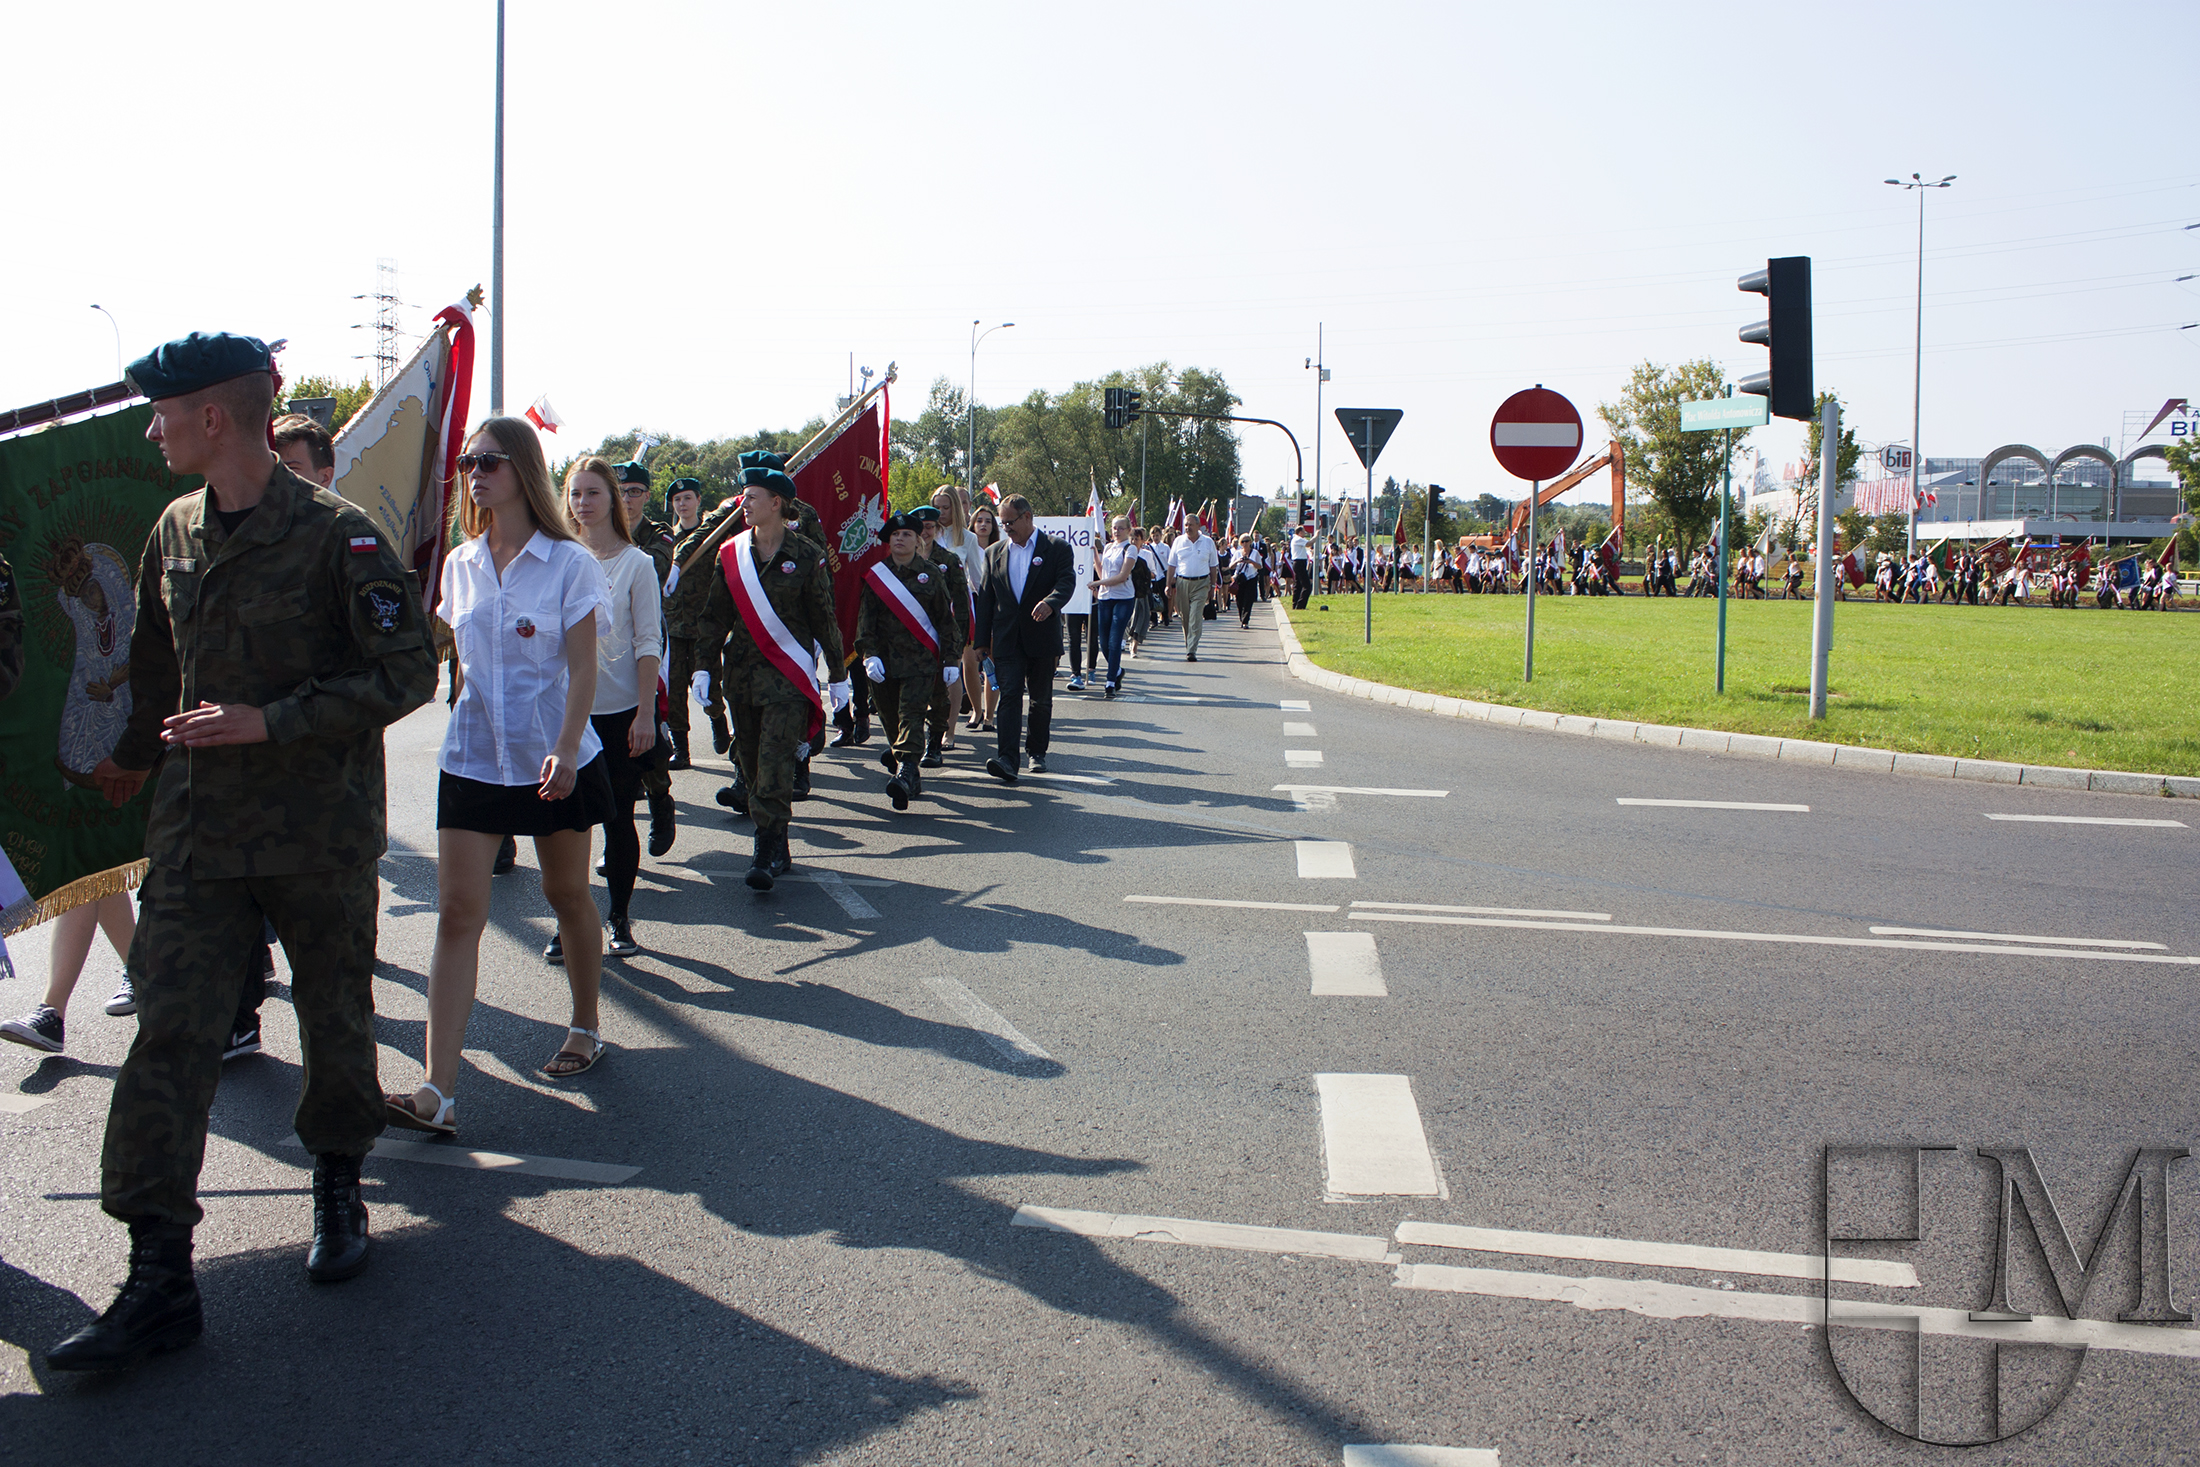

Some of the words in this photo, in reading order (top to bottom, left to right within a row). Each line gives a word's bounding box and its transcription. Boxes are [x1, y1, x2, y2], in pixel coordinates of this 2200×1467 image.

[1684, 411, 1696, 422] Plac
[1698, 408, 1721, 421] Witolda
[1722, 405, 1763, 419] Antonowicza
[1886, 448, 1911, 467] bi1
[832, 470, 849, 501] 1928
[1043, 525, 1090, 547] iraka
[827, 543, 842, 573] 1989
[358, 580, 403, 597] ROZPOZNANIE
[3, 779, 61, 827] NIECH
